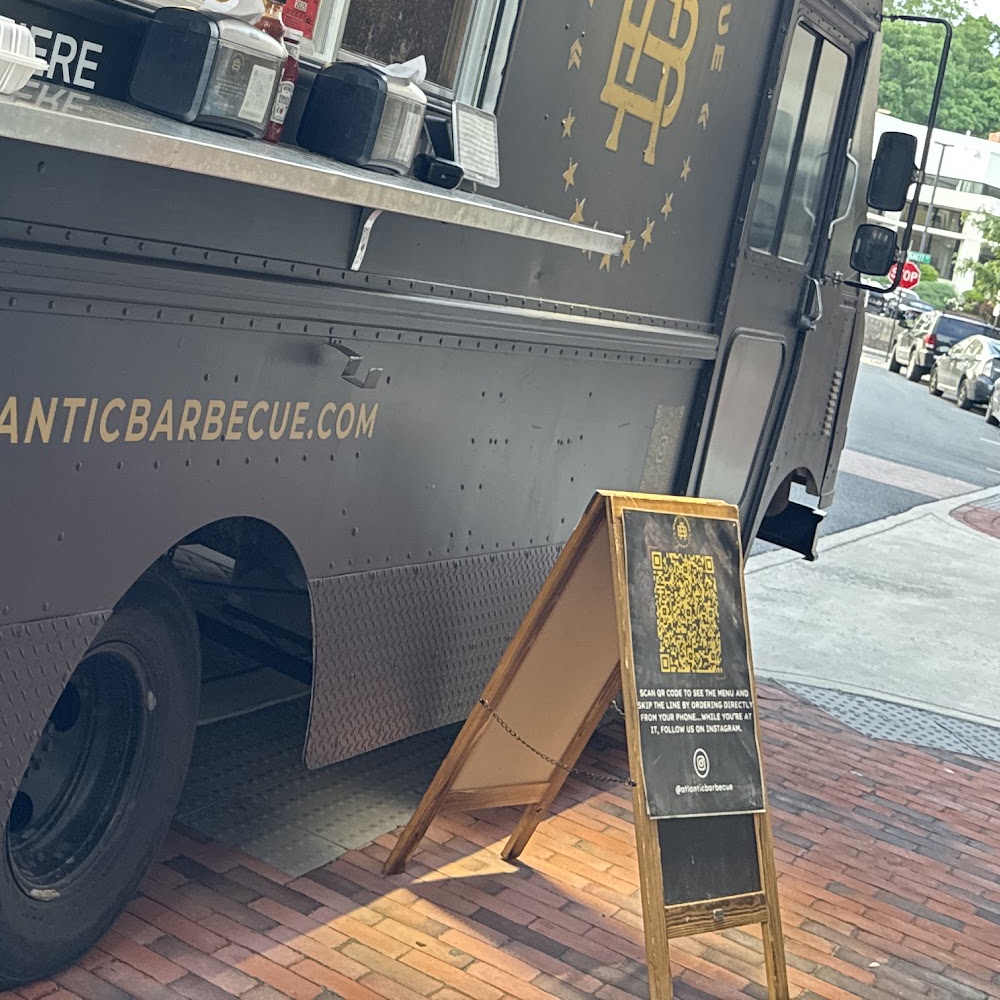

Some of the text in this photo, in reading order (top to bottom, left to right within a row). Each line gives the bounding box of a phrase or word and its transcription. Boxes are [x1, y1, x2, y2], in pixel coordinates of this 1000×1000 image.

[19, 22, 103, 90] ERE
[890, 266, 919, 283] SOP
[640, 689, 749, 697] SCAN QR CODE TO SEE THE MENU AND
[638, 701, 652, 709] SKIP
[654, 701, 665, 709] THE
[666, 701, 681, 709] LINE
[682, 701, 689, 709] BY
[691, 701, 722, 709] ORDERING
[641, 713, 657, 721] FROM
[659, 713, 674, 721] YOUR
[651, 726, 660, 735] IT,
[661, 725, 685, 733] FOLLOW
[686, 725, 694, 733] US
[696, 725, 705, 733] ON
[675, 783, 734, 795] @atlanticbarbecue
